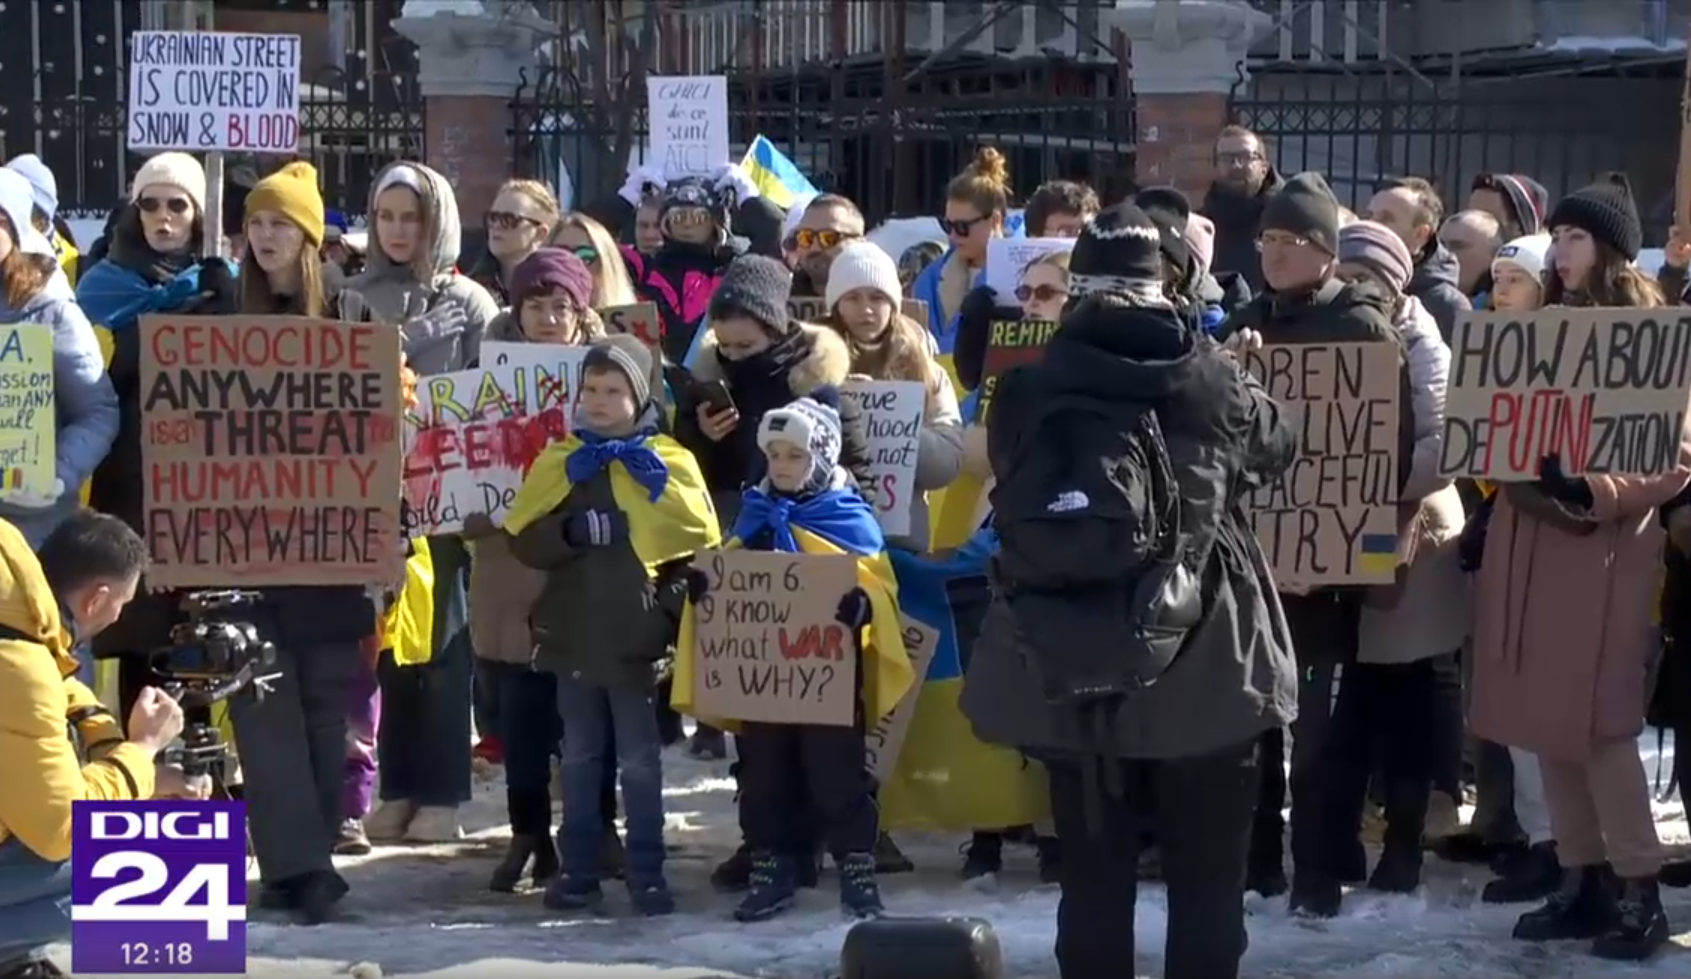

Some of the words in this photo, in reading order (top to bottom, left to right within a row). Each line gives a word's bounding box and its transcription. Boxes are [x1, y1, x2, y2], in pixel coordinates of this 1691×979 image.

[133, 33, 225, 68] UKRAINIAN
[231, 36, 299, 68] STREET
[137, 69, 161, 107] IS
[174, 69, 269, 109] COVERED
[276, 69, 294, 109] IN
[132, 112, 191, 145] SNOW
[199, 114, 218, 147] &
[227, 113, 298, 149] BLOOD
[153, 324, 376, 370] GENOCIDE
[1455, 320, 1569, 388] HOW
[1571, 316, 1691, 390] ABOUT
[145, 369, 382, 411] ANYWHERE
[405, 361, 585, 431] RAIN
[195, 410, 372, 456] THREAT
[1302, 399, 1392, 456] LIVE
[1439, 389, 1683, 477] DEPUTINIZATION
[876, 444, 915, 468] not
[153, 459, 377, 502] HUMANITY
[150, 506, 382, 565] EVERYWHERE
[729, 570, 771, 593] am
[700, 626, 769, 661] what
[778, 624, 845, 661] WAR
[705, 670, 722, 690] is
[738, 665, 835, 703] WHY?
